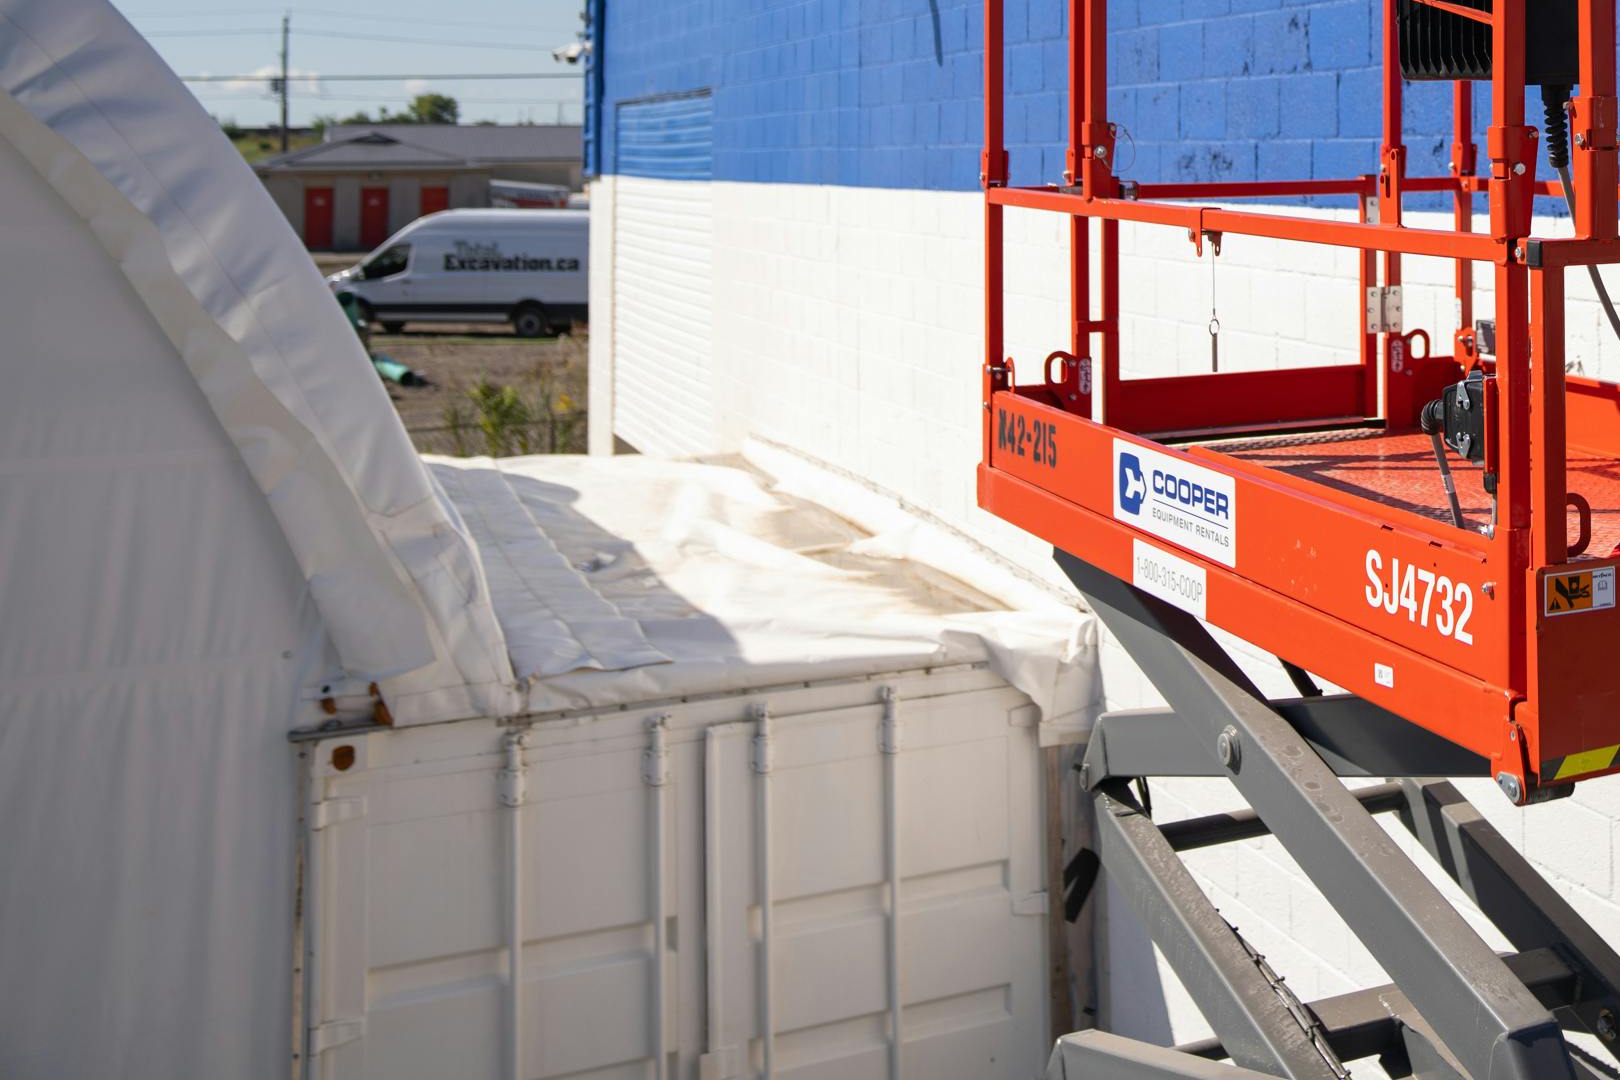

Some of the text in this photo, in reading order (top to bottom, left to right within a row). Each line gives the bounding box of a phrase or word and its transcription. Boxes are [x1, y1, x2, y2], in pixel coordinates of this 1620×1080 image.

[443, 251, 580, 271] Excavation.ca
[1152, 469, 1229, 520] COOPER
[1152, 507, 1230, 548] EQUIPMENT RENTALS
[1136, 556, 1203, 602] 1-800-315-COOP
[1365, 549, 1473, 646] SJ4732
